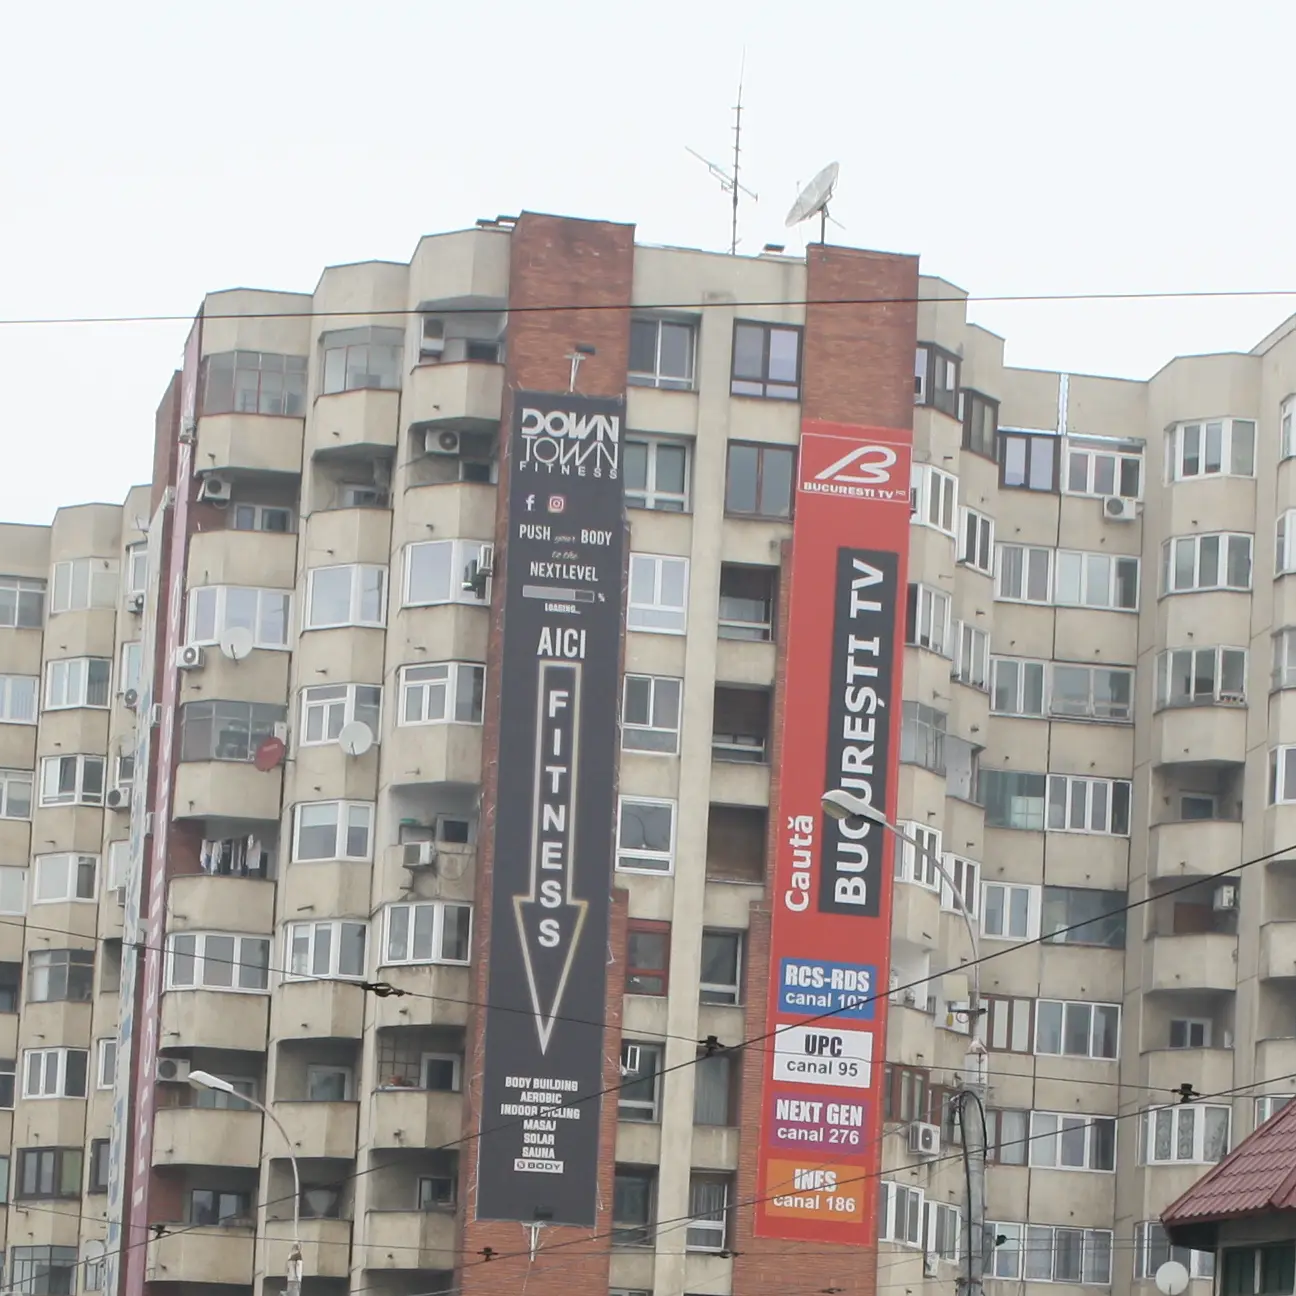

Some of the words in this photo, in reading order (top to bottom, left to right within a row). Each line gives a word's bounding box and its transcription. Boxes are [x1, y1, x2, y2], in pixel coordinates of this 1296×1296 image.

[522, 408, 619, 443] DOWN
[522, 435, 618, 469] TOWN
[519, 460, 618, 479] FITNESS
[804, 481, 875, 497] BUCURESTI
[878, 489, 894, 499] TV
[519, 523, 551, 541] PUSH
[581, 529, 613, 546] BODY
[850, 557, 884, 619] TV
[536, 626, 587, 659] AICI
[538, 690, 569, 948] FITNESS
[785, 814, 813, 912] Caută
[785, 964, 870, 993] RCS-RDS
[785, 992, 833, 1009] canal
[838, 995, 868, 1011] 107
[804, 1034, 843, 1057] UPC
[786, 1057, 833, 1075] canal
[838, 1061, 858, 1077] 95
[505, 1076, 532, 1089] BODY
[533, 1078, 579, 1091] BUILDING
[520, 1091, 562, 1104] AEROBIC
[500, 1103, 538, 1116] INDOOR
[776, 1098, 823, 1124] NEXT
[827, 1104, 863, 1127] GEN
[523, 1119, 557, 1131] MASAJ
[777, 1125, 824, 1142] canal
[828, 1128, 860, 1145] 276
[523, 1132, 555, 1145] SOLAR
[521, 1146, 556, 1159] SAUNA
[527, 1162, 561, 1170] BODY
[793, 1168, 838, 1193] INES
[773, 1193, 820, 1210] canal
[825, 1196, 856, 1213] 186
